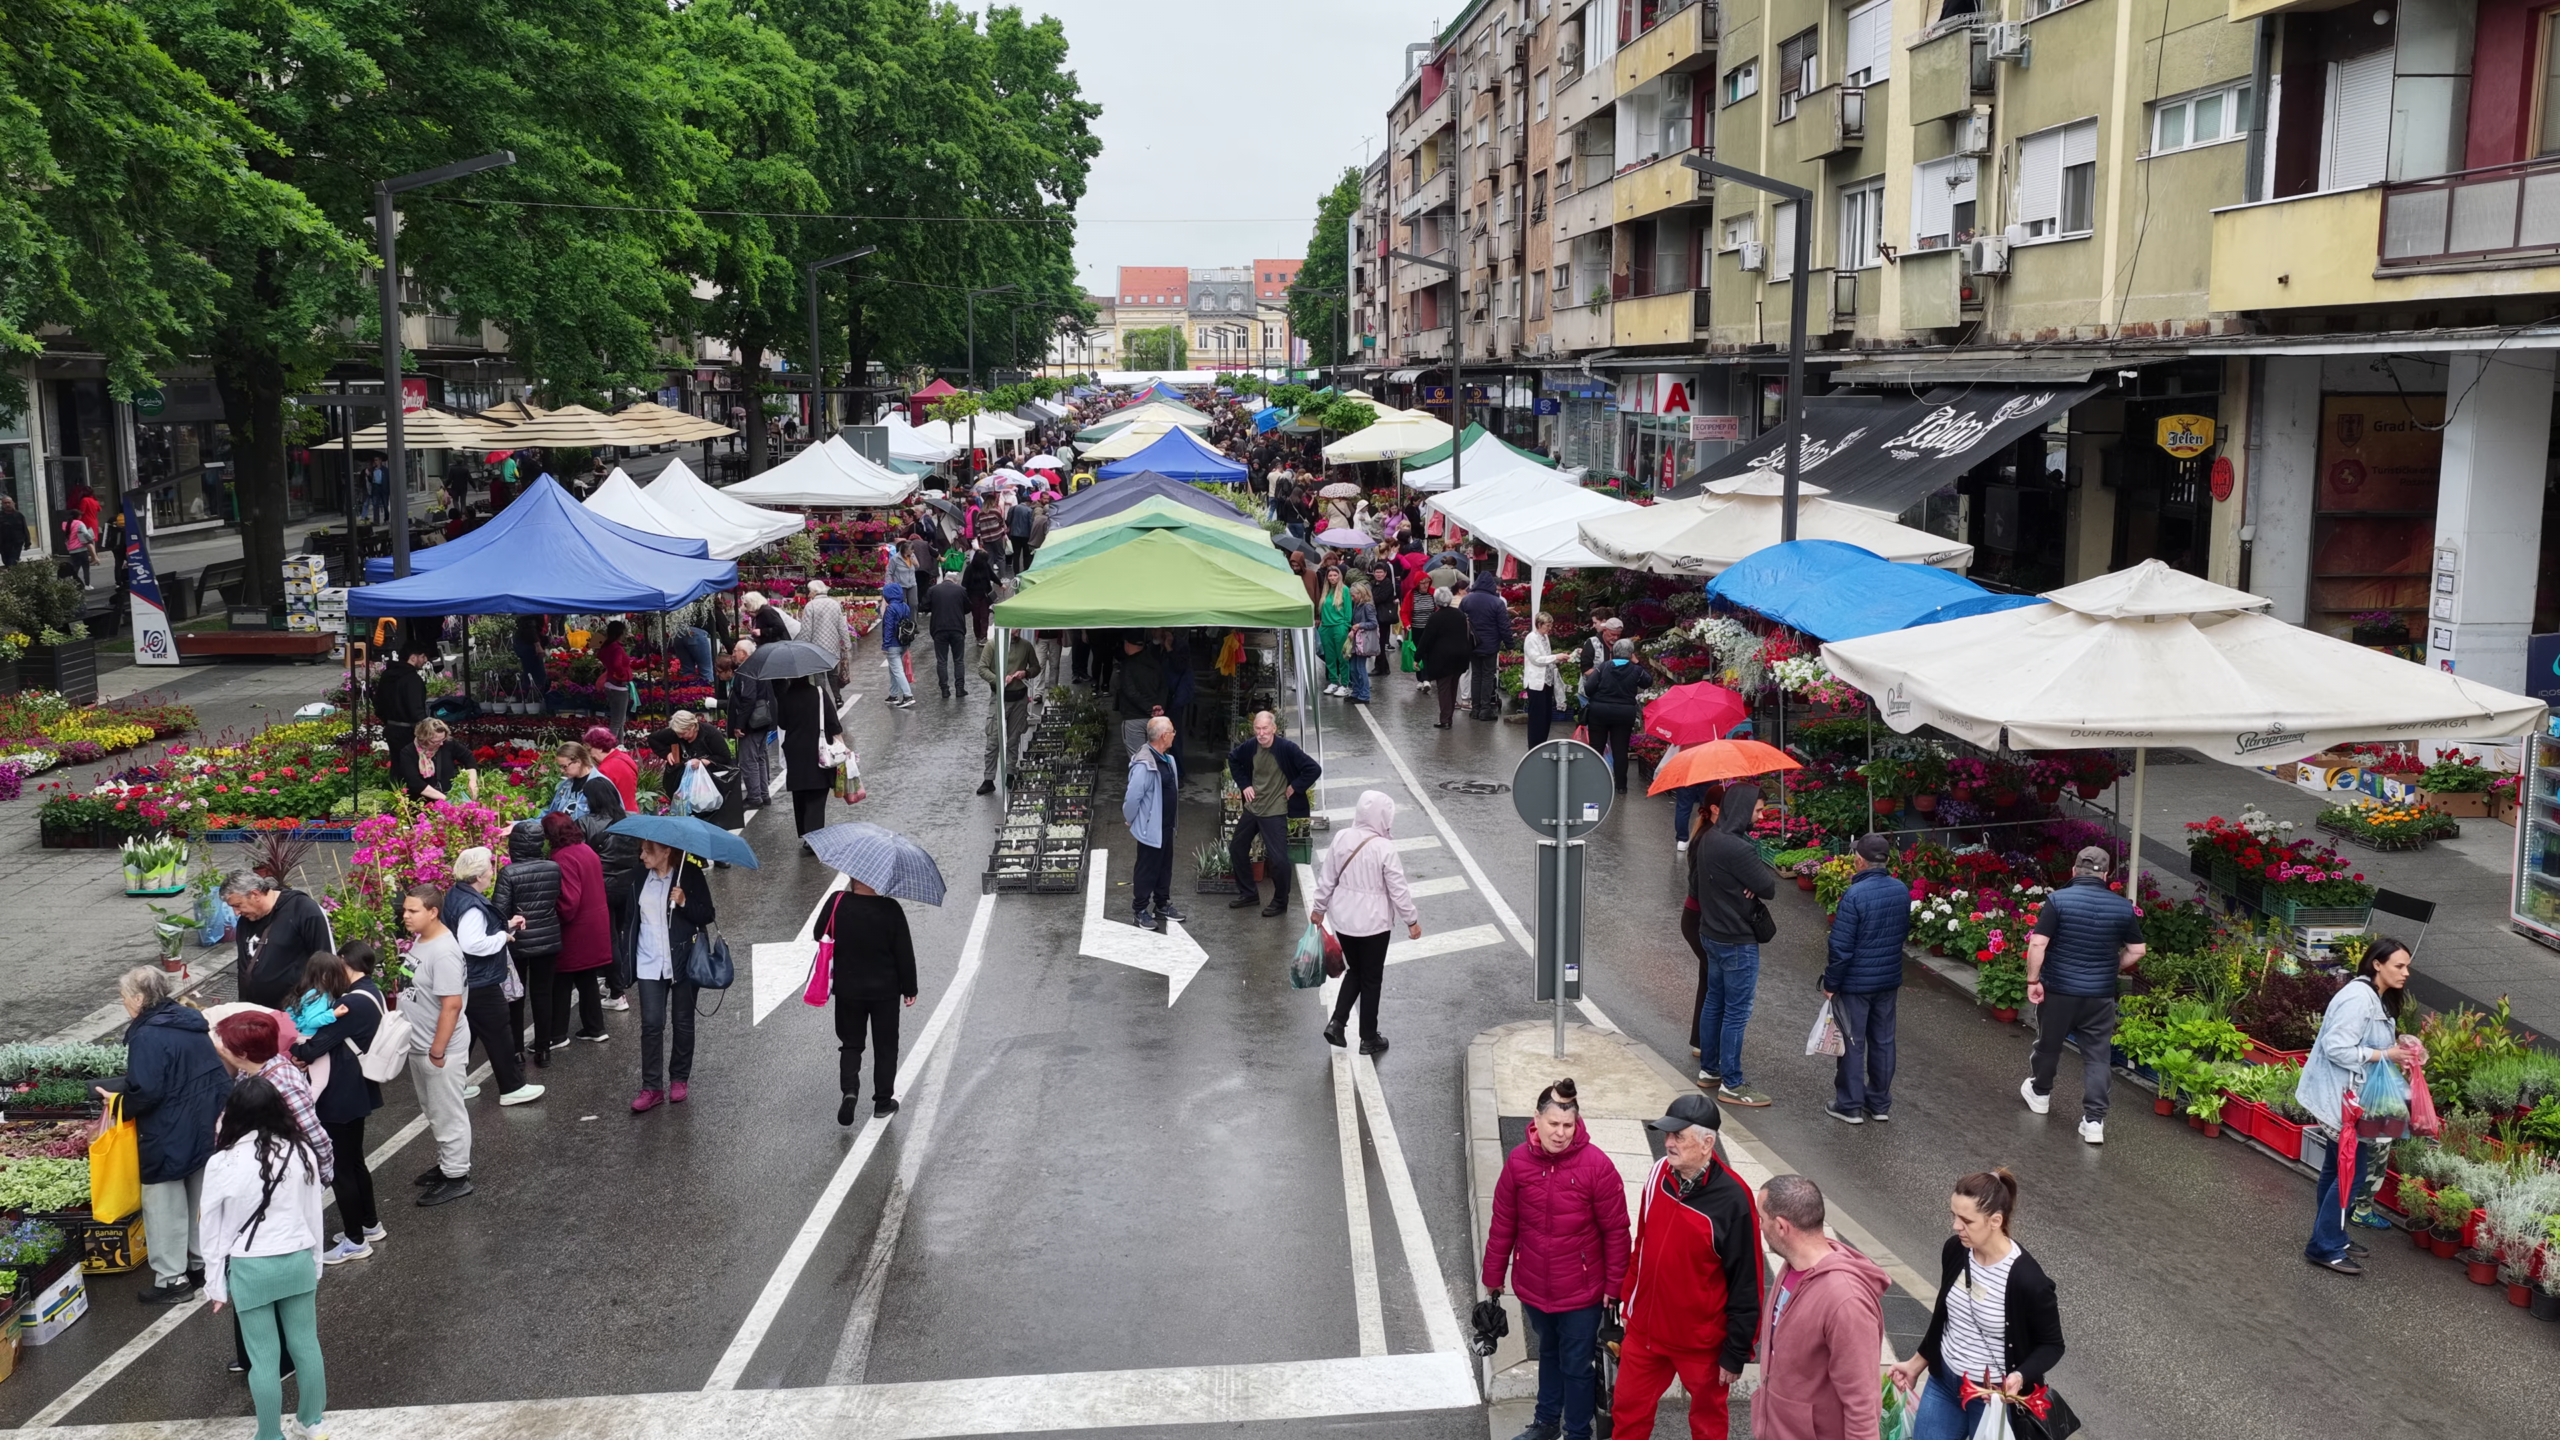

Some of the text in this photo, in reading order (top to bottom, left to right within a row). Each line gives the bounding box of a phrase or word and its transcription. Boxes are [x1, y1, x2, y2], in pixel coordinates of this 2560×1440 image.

[402, 386, 424, 409] Smiley
[2373, 420, 2405, 432] Grad
[2167, 431, 2204, 446] Jelen
[2419, 718, 2469, 730] PRAGA
[2070, 729, 2154, 738] DUH PRAGA
[2235, 730, 2309, 755] Staropramen
[95, 1229, 123, 1237] Banana
